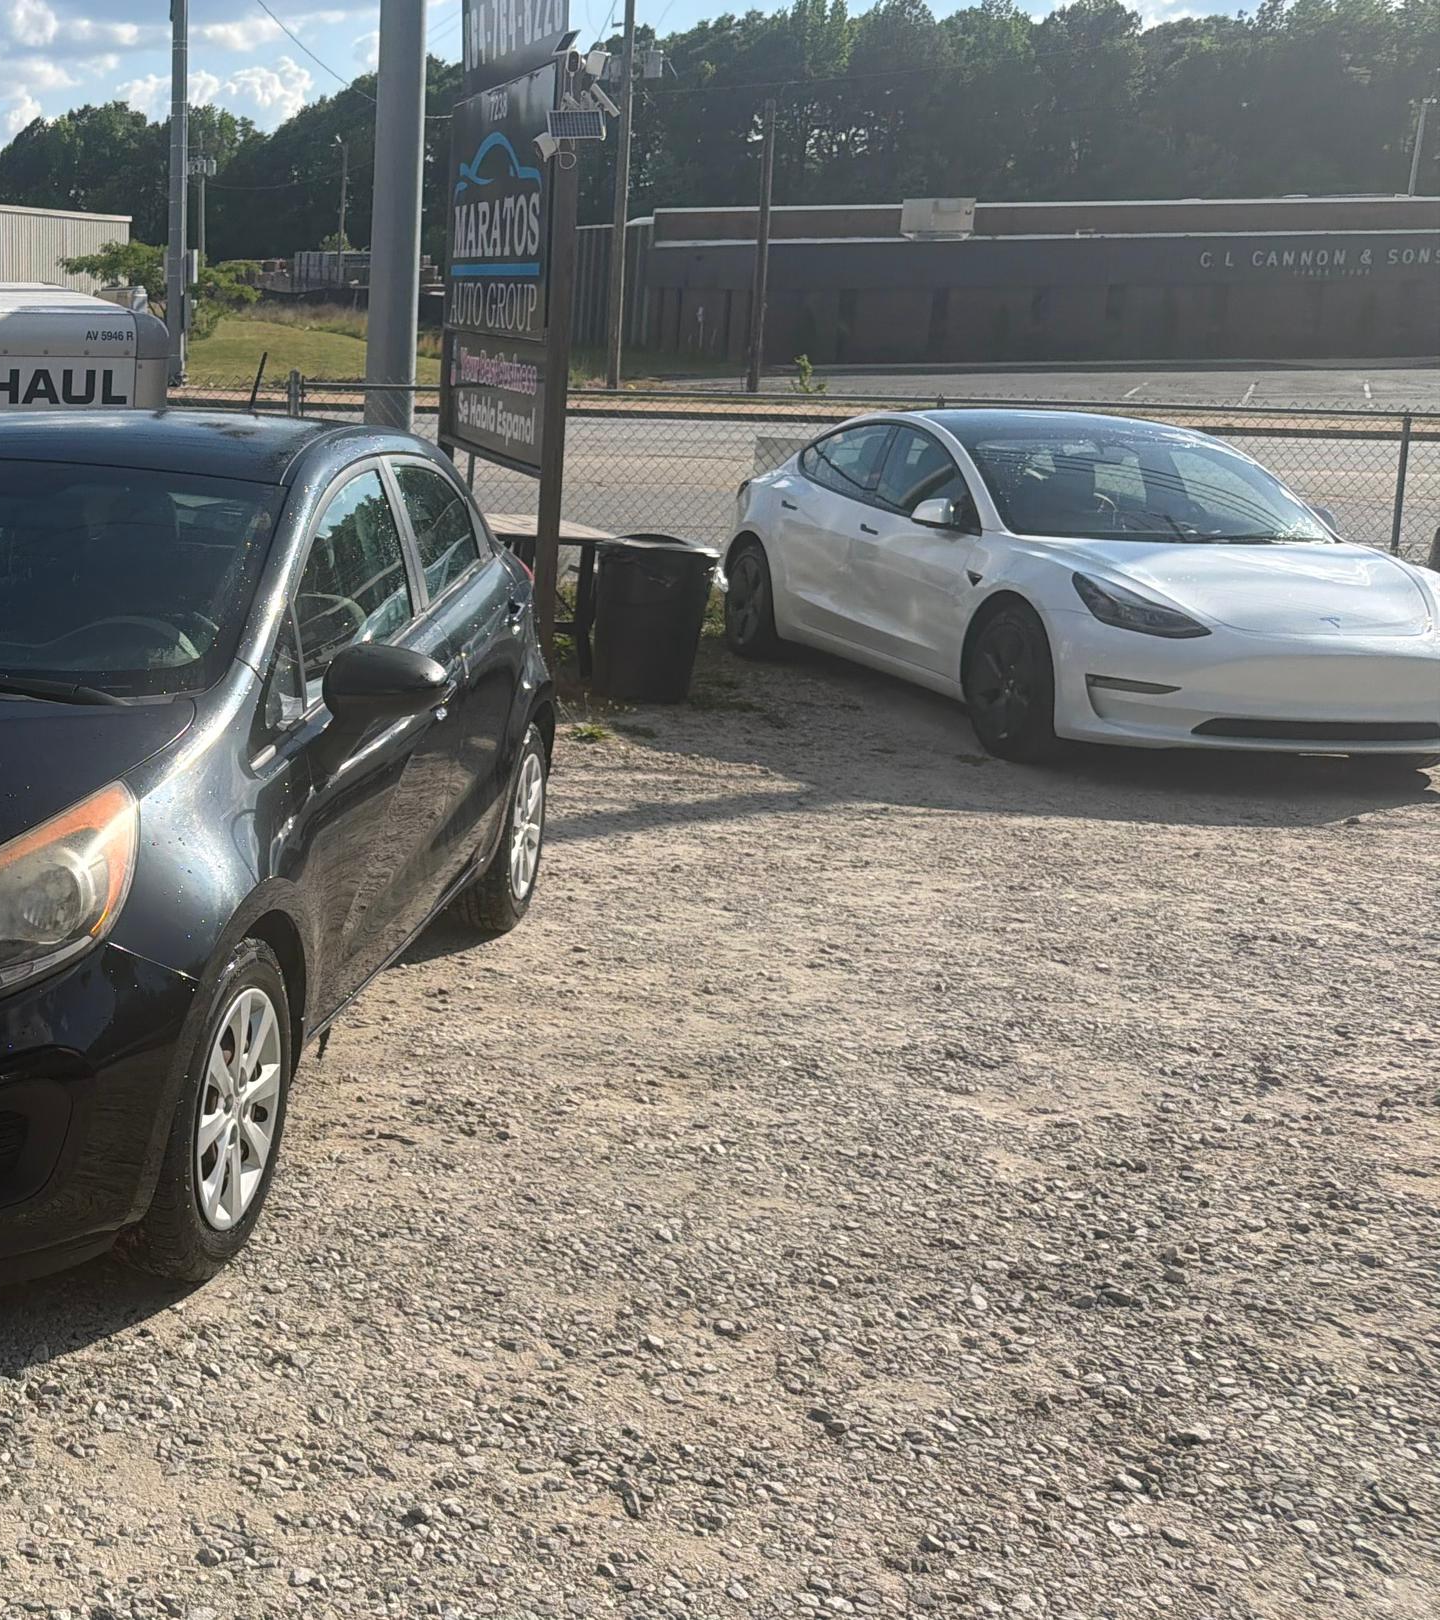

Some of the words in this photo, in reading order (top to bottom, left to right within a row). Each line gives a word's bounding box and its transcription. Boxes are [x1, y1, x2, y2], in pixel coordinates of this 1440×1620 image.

[453, 192, 540, 258] MARATOS
[1252, 250, 1347, 267] CANNON
[1360, 248, 1373, 265] &
[449, 282, 483, 326] AUTO
[486, 282, 537, 331] GROUP
[85, 331, 99, 341] AV
[101, 331, 124, 341] 5946
[126, 331, 134, 341] R
[458, 390, 469, 424] Se
[469, 393, 496, 432] Habla
[496, 400, 536, 447] Espanol
